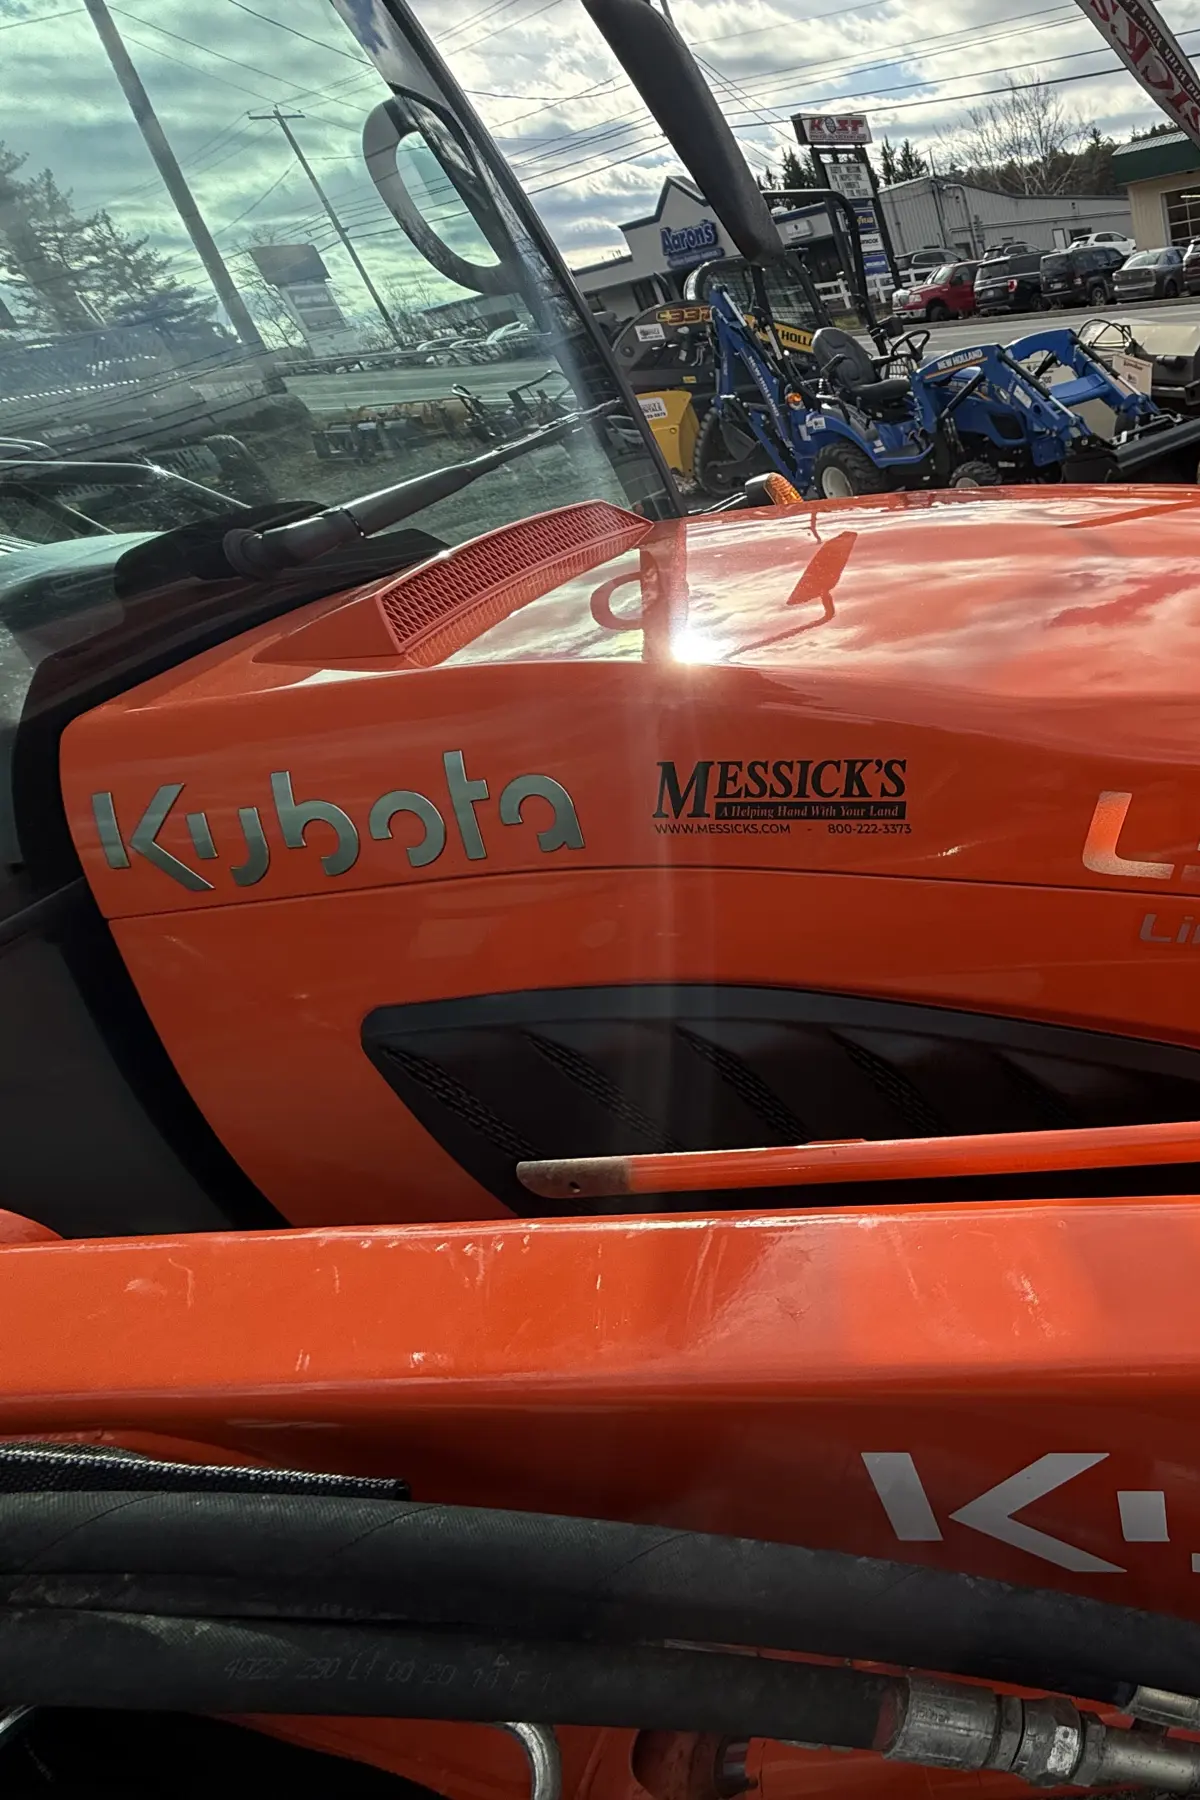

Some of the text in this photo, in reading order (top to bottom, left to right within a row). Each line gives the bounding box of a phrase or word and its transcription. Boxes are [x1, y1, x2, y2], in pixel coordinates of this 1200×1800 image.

[1141, 15, 1163, 48] Your
[1164, 48, 1188, 82] With
[936, 349, 983, 370] NEW HOLLAND
[748, 355, 780, 416] NEW HOLLAND
[652, 758, 907, 820] MESSICK'S
[92, 750, 586, 891] Kubota
[720, 803, 900, 820] A Helping Hand With Your Land
[654, 824, 792, 835] WWW.MESSICKS.COM
[827, 824, 912, 835] 800-222-3373
